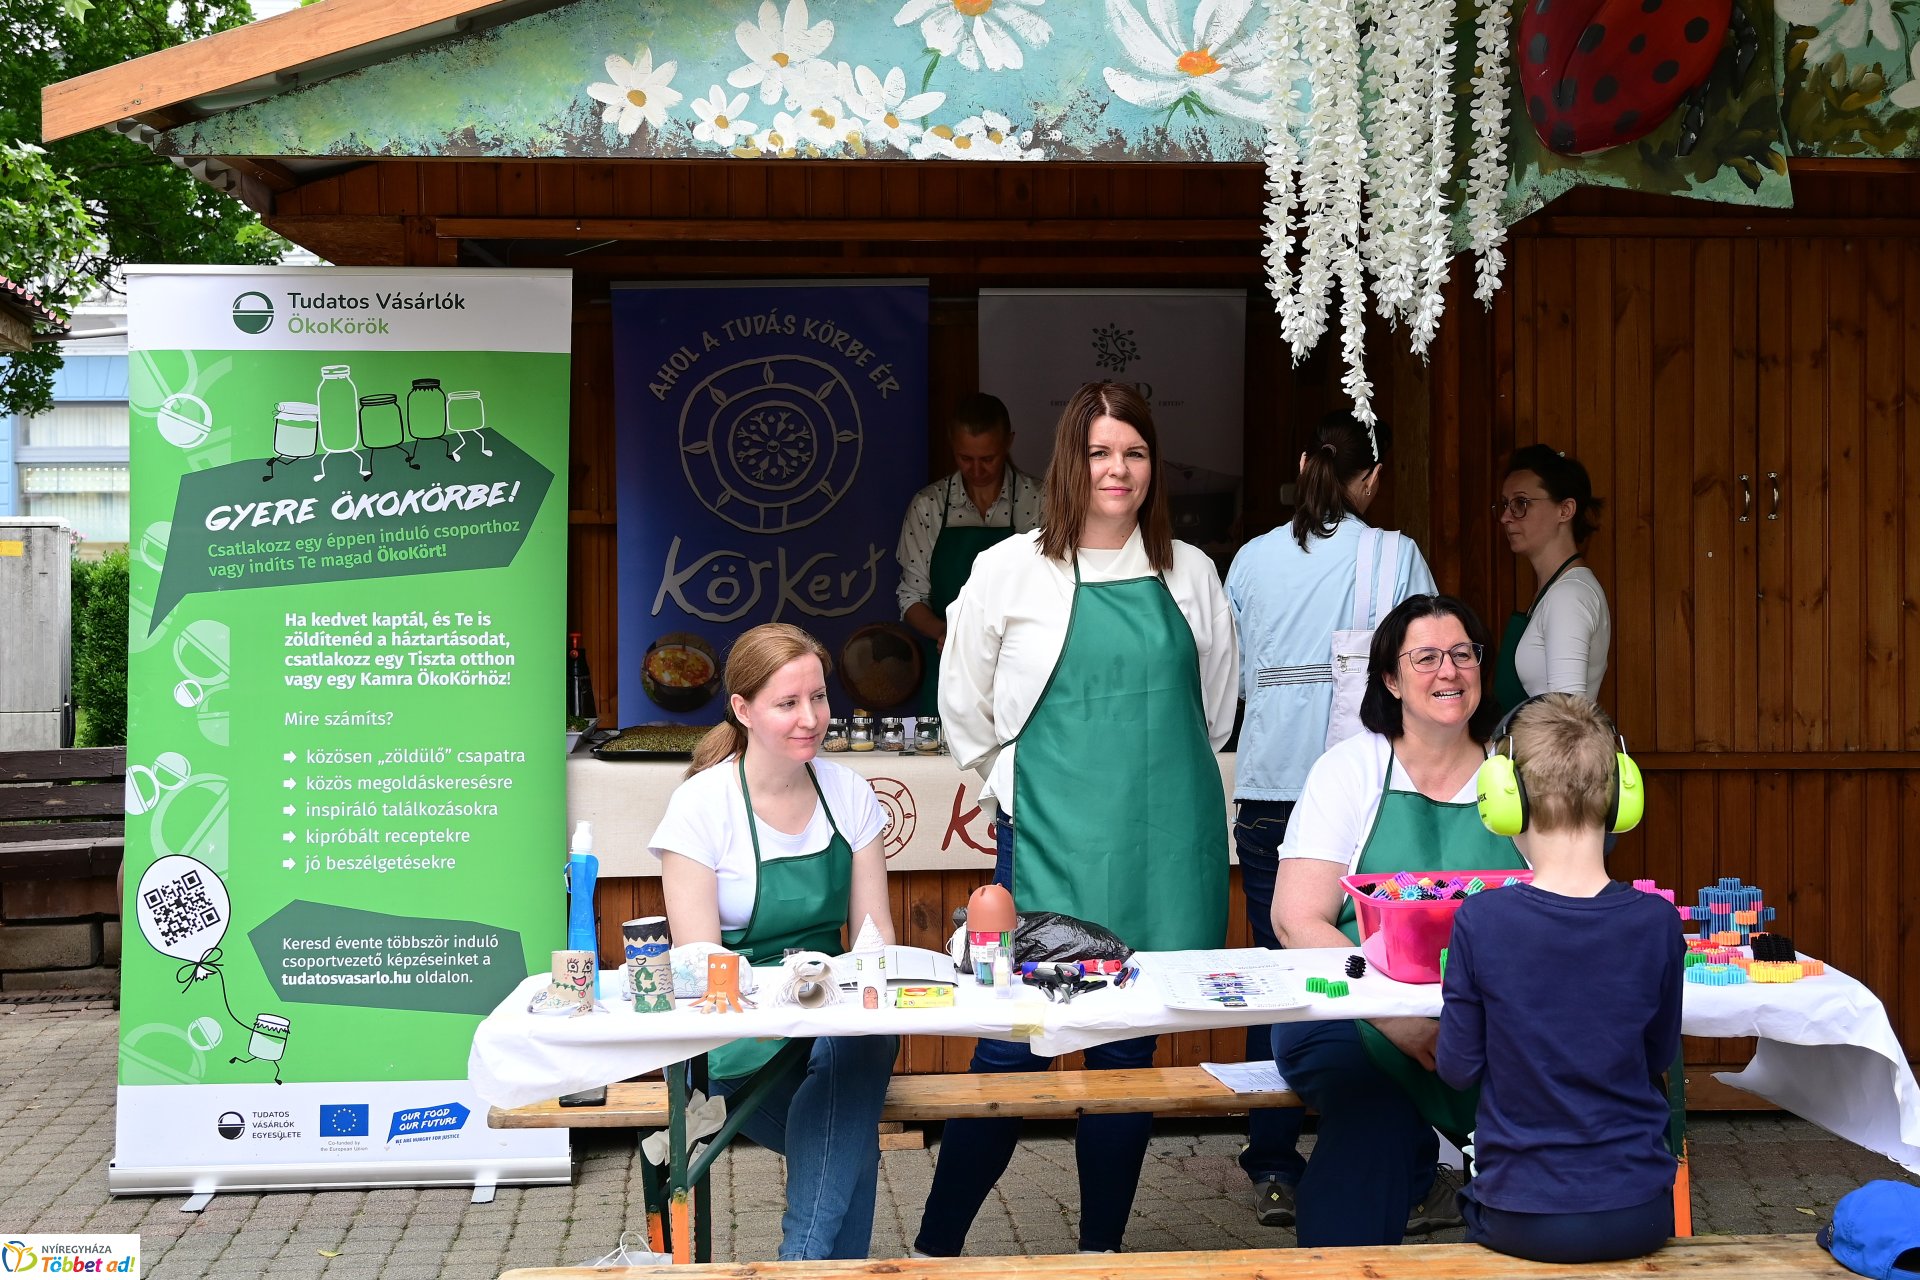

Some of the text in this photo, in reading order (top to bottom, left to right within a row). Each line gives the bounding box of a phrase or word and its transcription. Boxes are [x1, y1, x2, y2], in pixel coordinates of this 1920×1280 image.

[288, 292, 465, 310] Tudatos Vásárlók
[288, 313, 389, 335] ÖkoKörök
[648, 308, 901, 400] AHOL A TUDÁS KÖRBE ÉR
[205, 481, 520, 531] GYERE ÖKOKÖRBE!
[208, 520, 520, 558] Csatlakozz egy éppen induló csoporthoz
[209, 544, 446, 578] vagy indíts Te magad ÖkoKört!
[286, 611, 491, 630] Ha kedvet kaptál, és Te is
[285, 630, 510, 649] zöldítenéd a háztartásodat,
[285, 651, 514, 670] csatlakozz egy Tiszta otthon
[285, 668, 510, 689] vagy egy Kamra ÖkoKörhöz!
[285, 710, 393, 726] Mire számíts?
[307, 749, 371, 764] közösen
[457, 750, 525, 767] csapatra
[307, 774, 512, 794] közös megoldáskeresésre
[307, 801, 497, 820] inspiráló találkozásokra
[307, 828, 470, 847] kipróbált receptekre
[305, 854, 455, 874] jó beszélgetésekre
[283, 934, 498, 950] Keresd évente többször induló
[283, 952, 490, 970] csoportvezető képzéseinket a
[282, 970, 472, 986] tudatosvasarlo.hu oldalon.
[252, 1120, 295, 1128] VÁSÁRLÓK
[399, 1117, 457, 1131] OUR FUTURE
[401, 1108, 451, 1121] OUR FOOD
[253, 1130, 301, 1140] EGYESÜLETE
